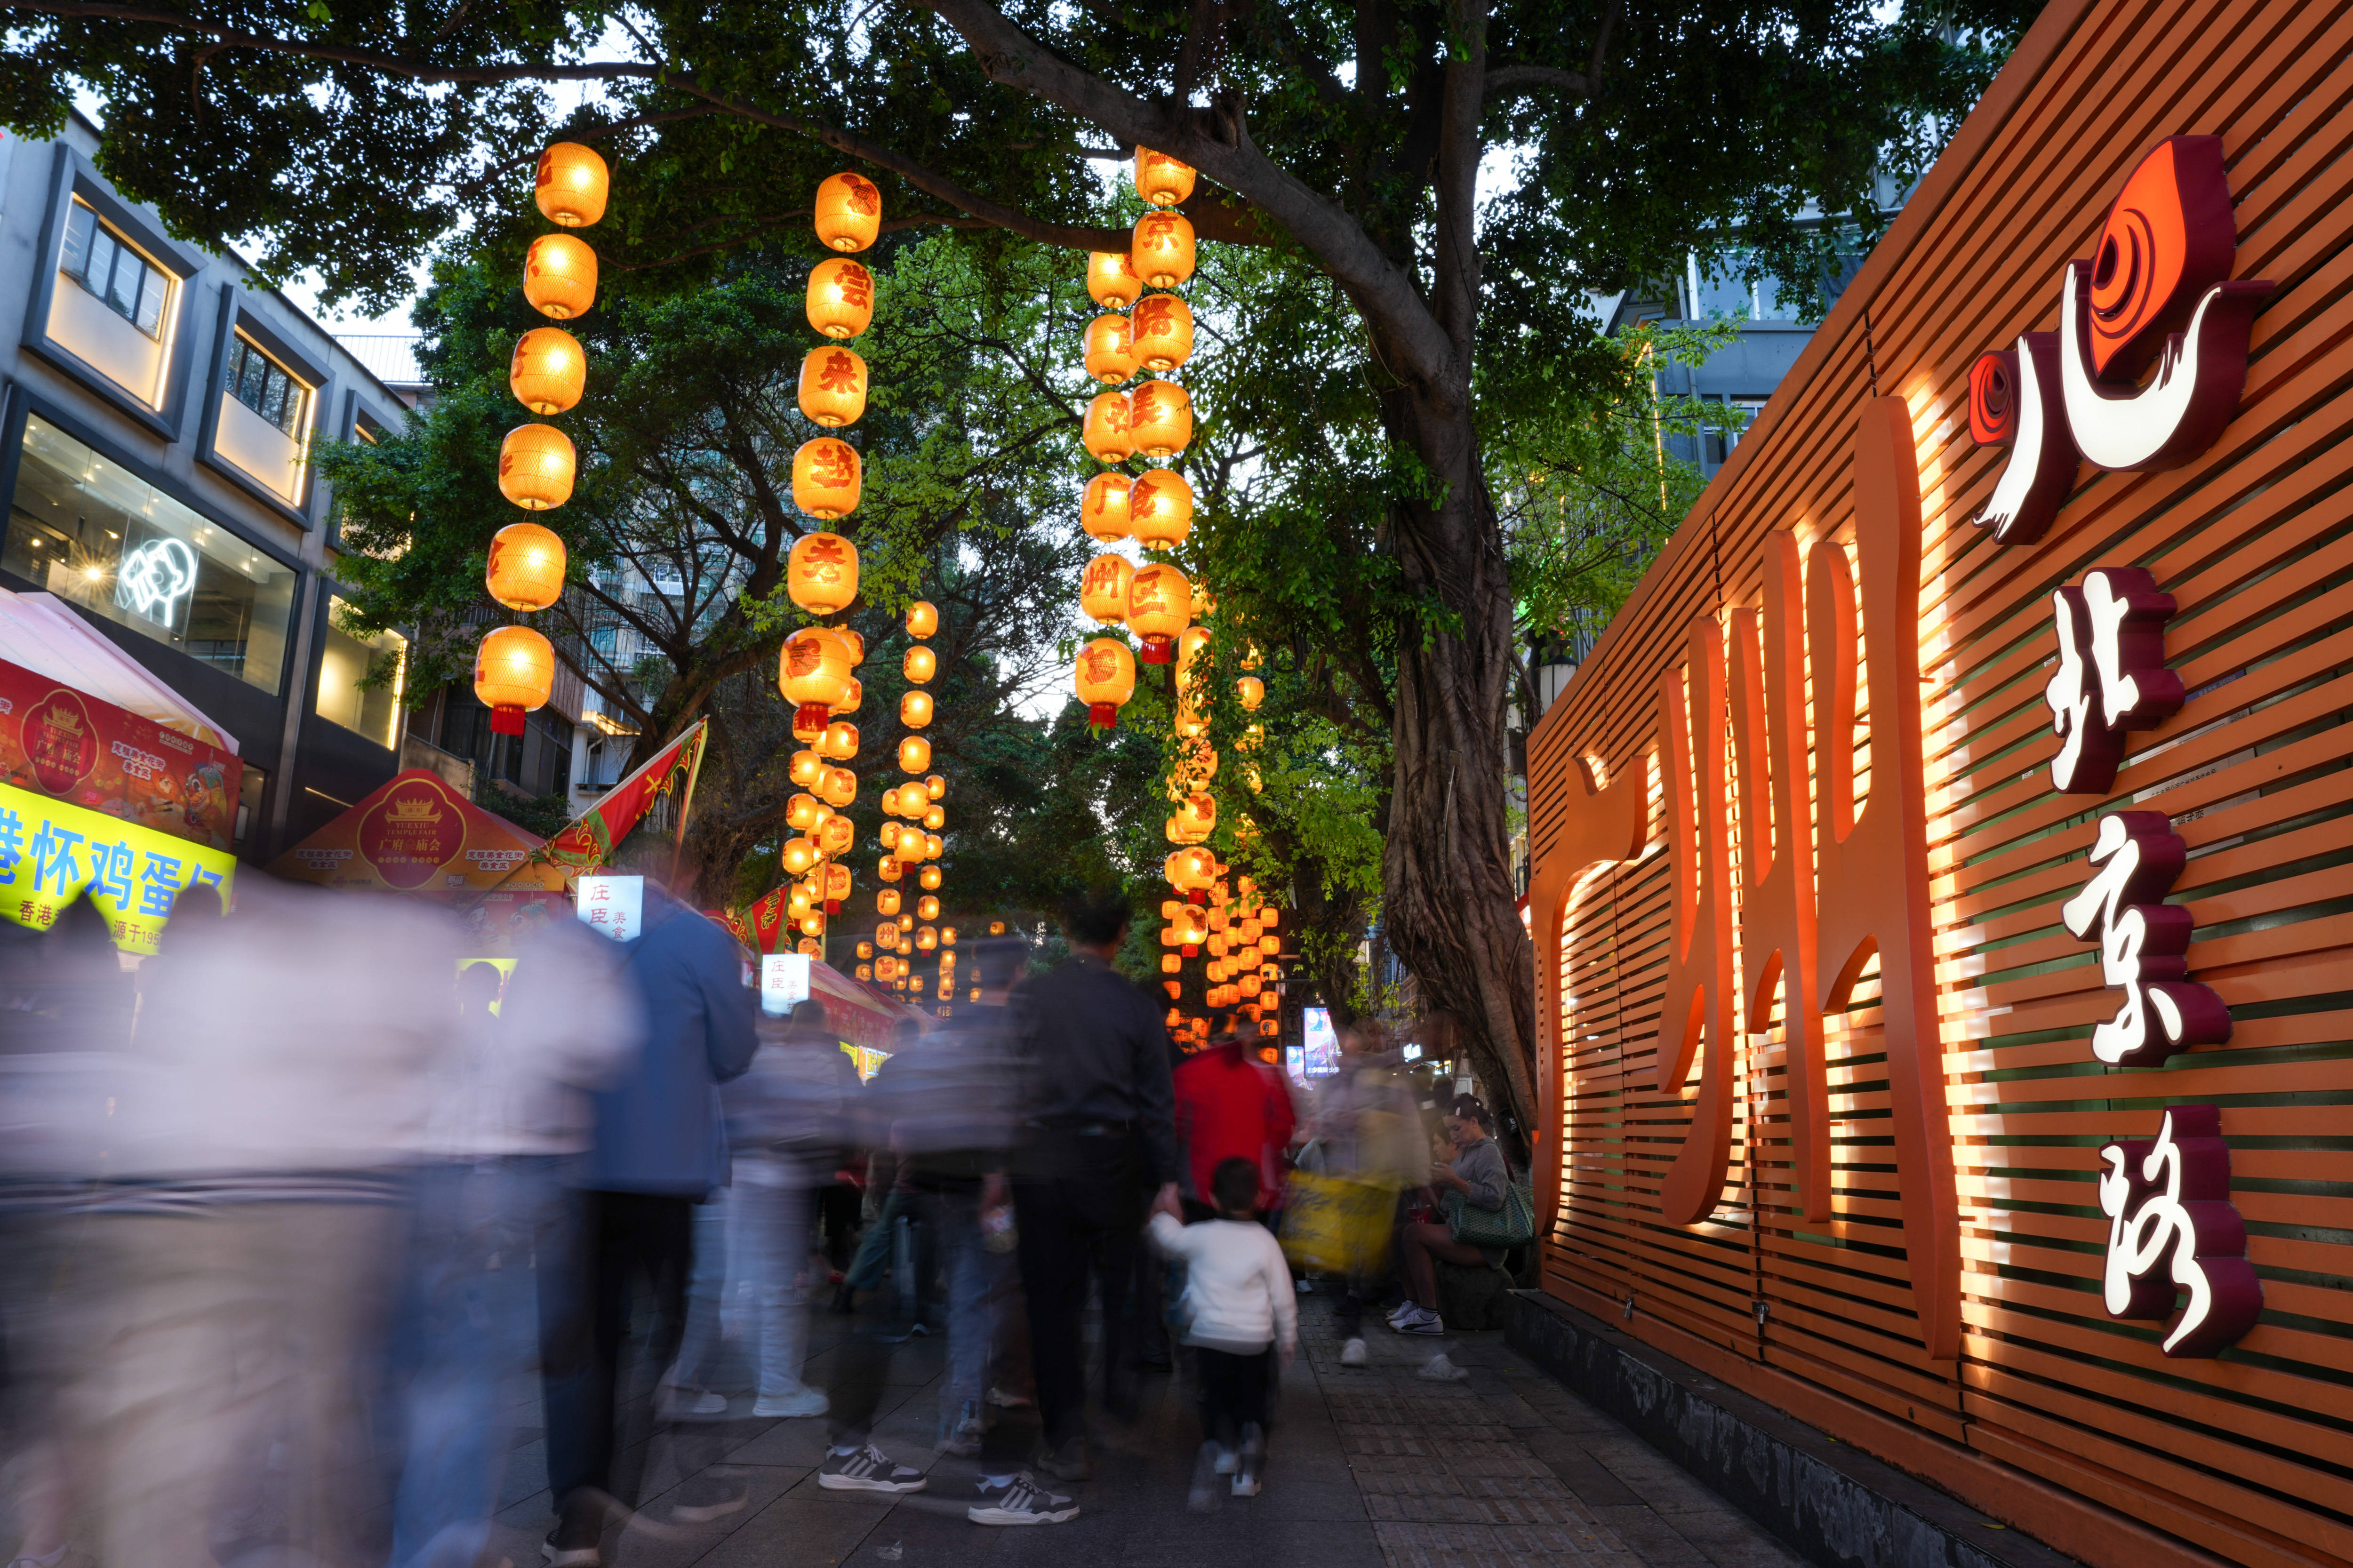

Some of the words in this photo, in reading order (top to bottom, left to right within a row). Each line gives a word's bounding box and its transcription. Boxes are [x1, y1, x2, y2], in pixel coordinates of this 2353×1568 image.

[480, 862, 508, 870] 美食区
[19, 900, 64, 926] 香港
[589, 884, 610, 925] 庄臣
[612, 911, 626, 940] 美食
[771, 960, 785, 989] 庄臣
[2045, 570, 2217, 1355] 北京路
